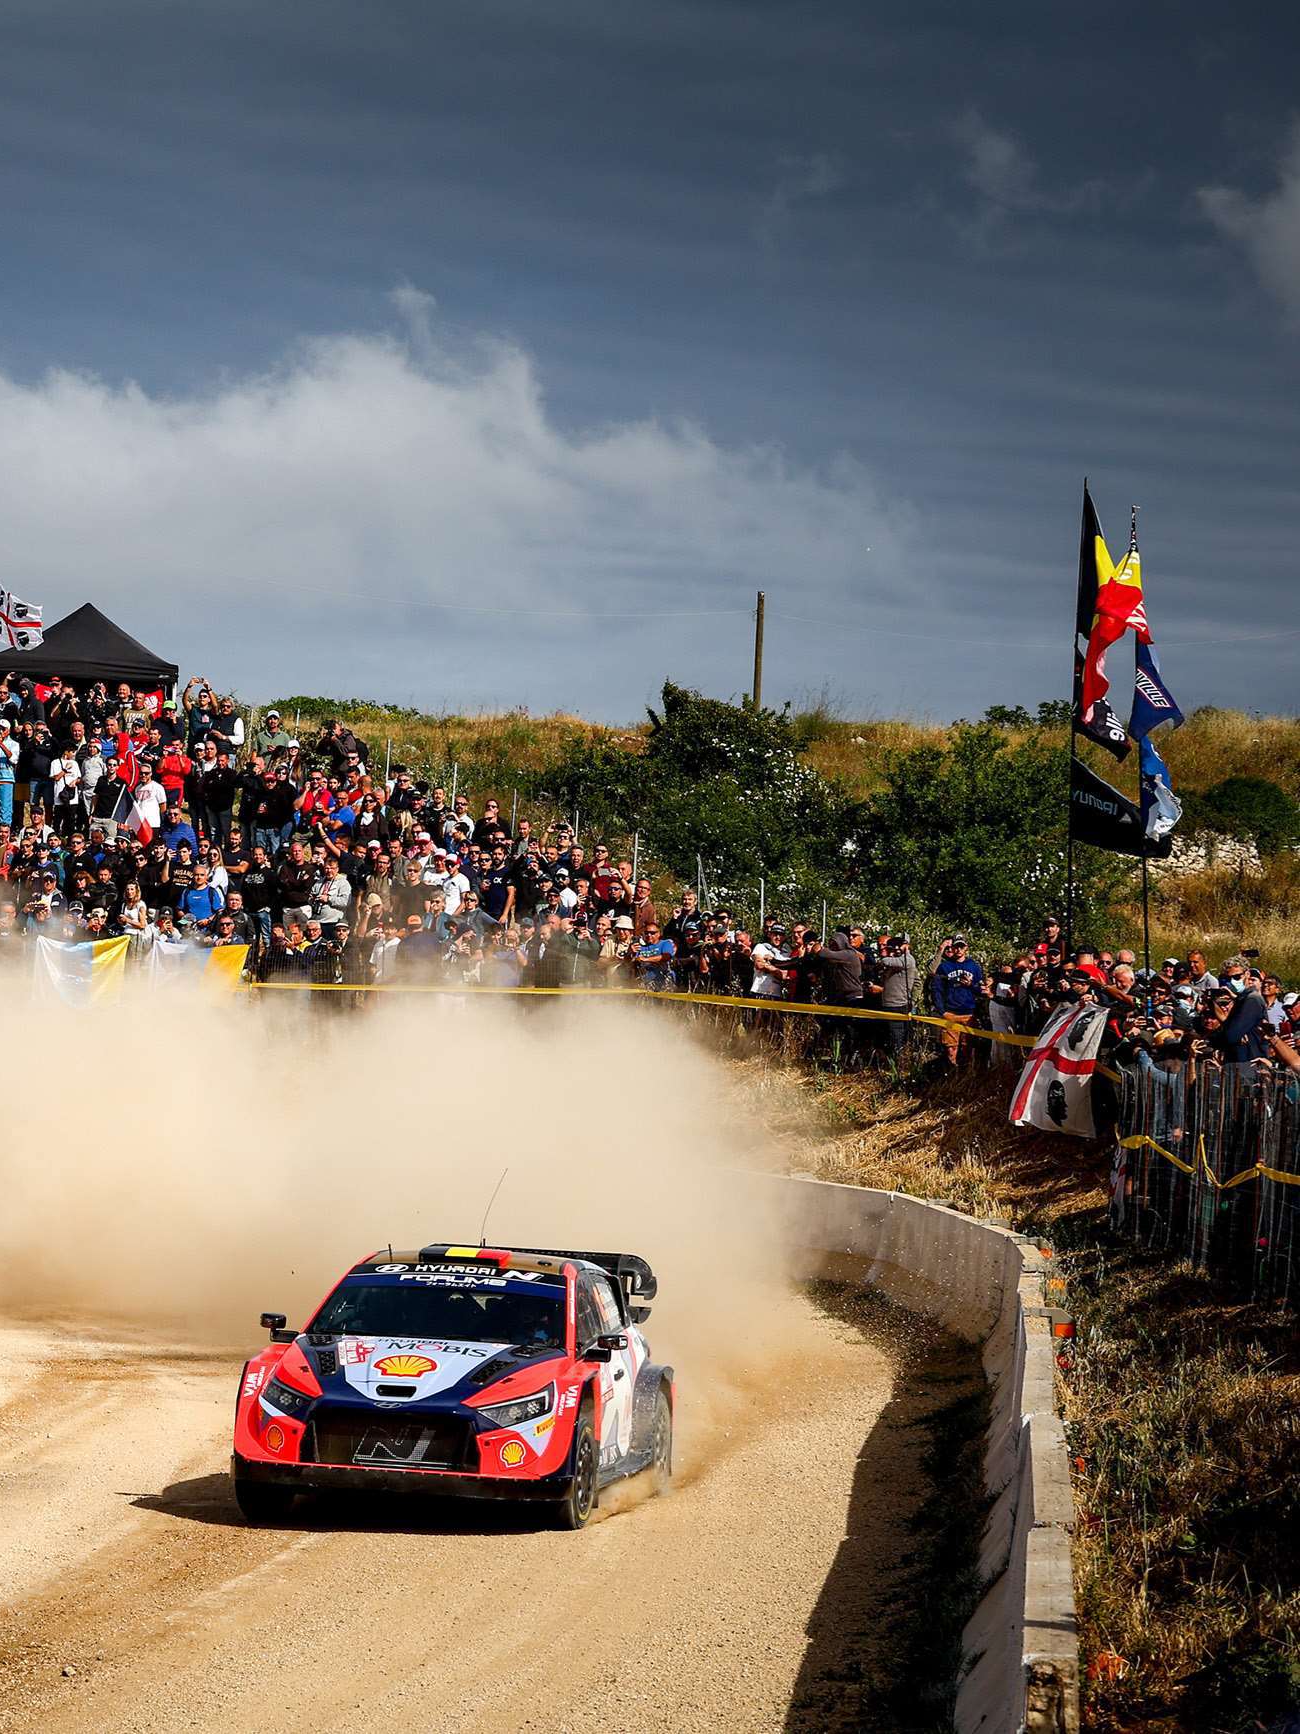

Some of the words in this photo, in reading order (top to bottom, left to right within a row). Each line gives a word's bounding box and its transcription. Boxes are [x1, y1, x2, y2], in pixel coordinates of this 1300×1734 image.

[415, 1264, 496, 1275] HYUNDAI
[399, 1274, 507, 1287] FORUM8
[388, 1342, 488, 1358] MOBIS
